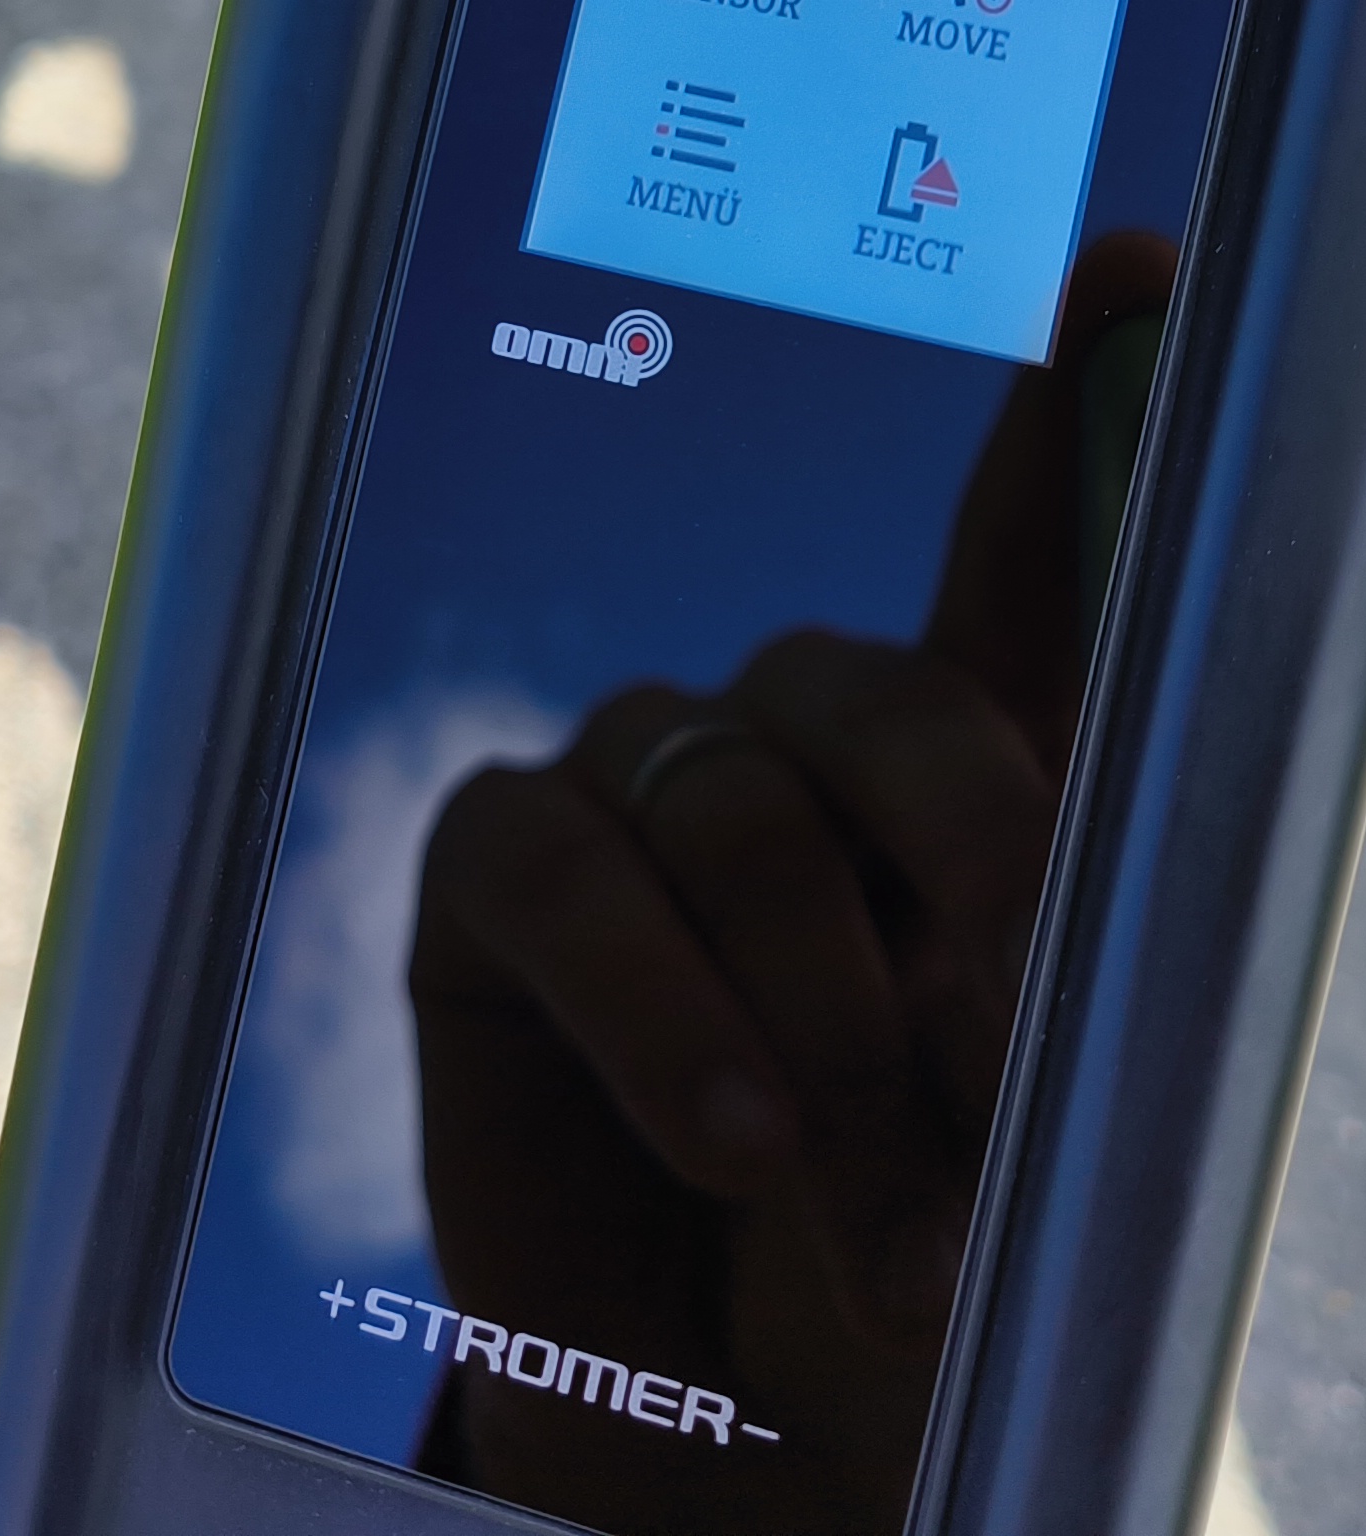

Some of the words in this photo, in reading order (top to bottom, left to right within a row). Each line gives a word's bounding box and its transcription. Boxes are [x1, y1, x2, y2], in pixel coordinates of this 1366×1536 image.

[896, 11, 1011, 61] MOVE
[626, 175, 742, 227] MENÜ
[853, 224, 964, 275] EJECT
